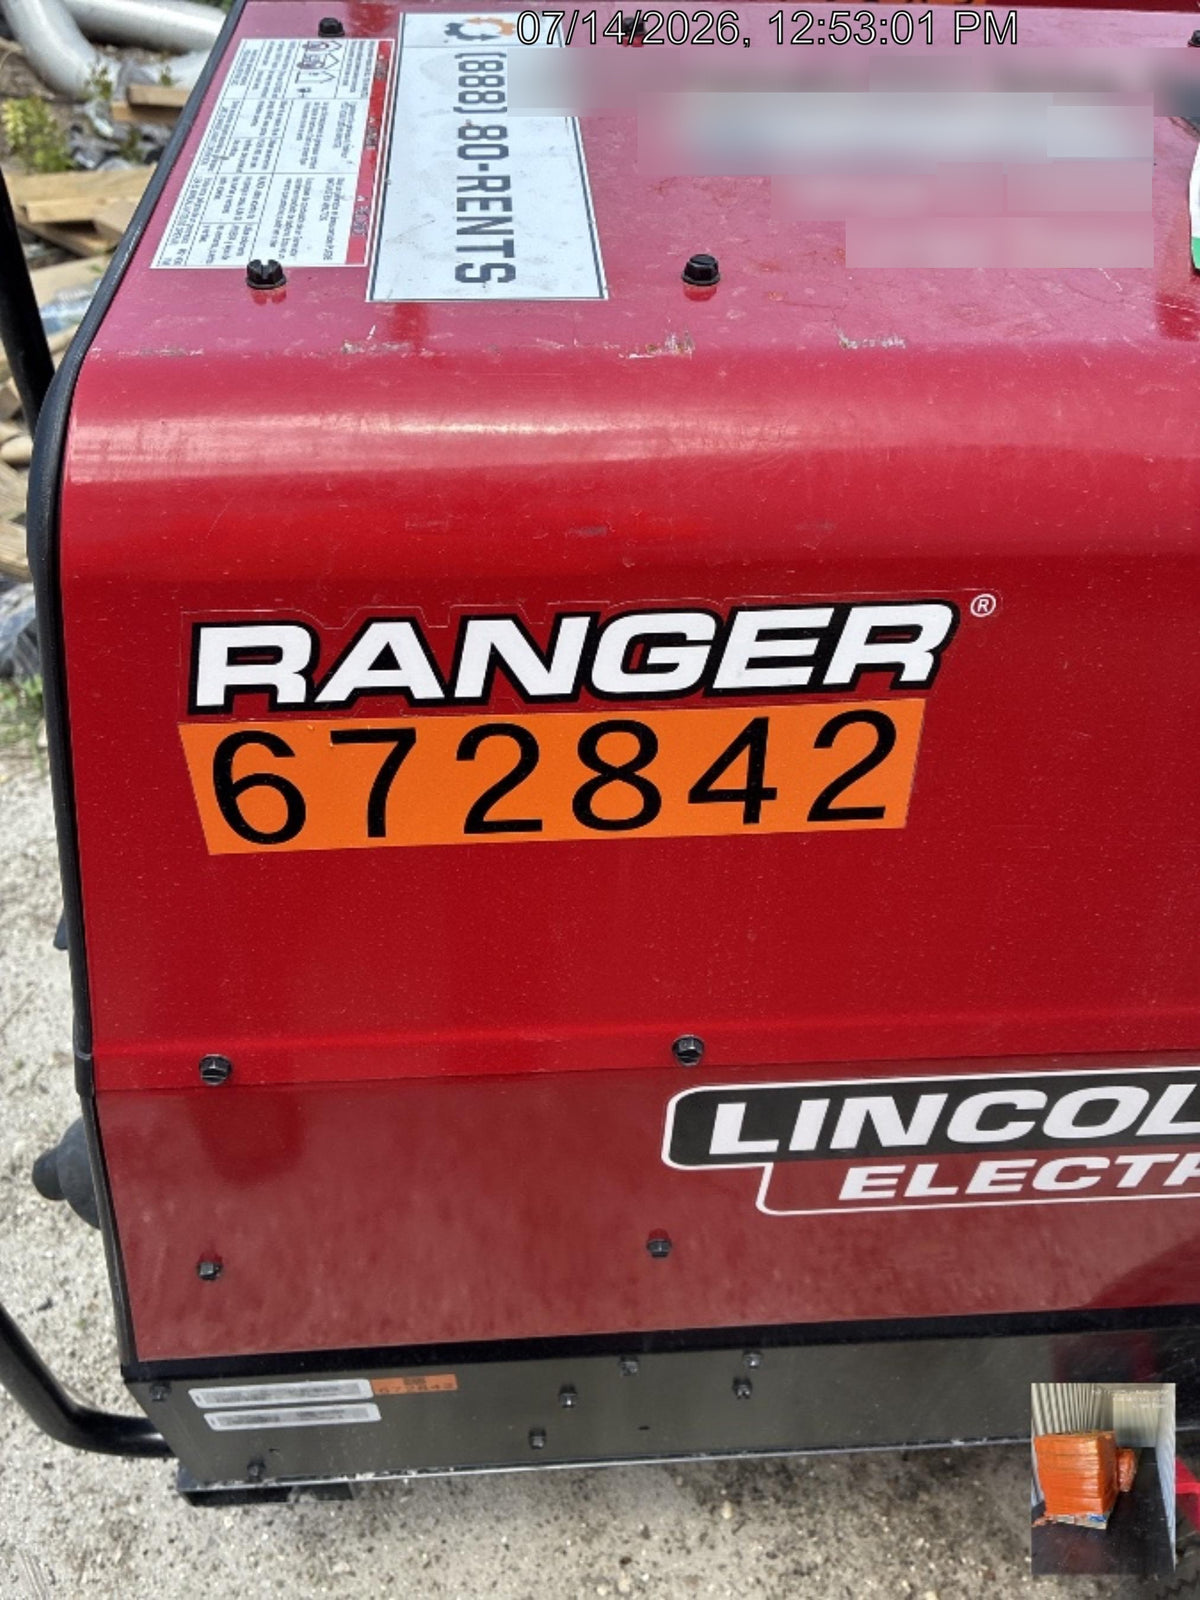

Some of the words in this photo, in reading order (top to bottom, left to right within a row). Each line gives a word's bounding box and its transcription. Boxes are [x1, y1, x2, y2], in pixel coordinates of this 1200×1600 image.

[453, 52, 508, 114] (888)
[455, 124, 516, 284] 80-RENTS
[190, 600, 959, 712] RANGER
[212, 709, 897, 845] 672842
[708, 1083, 1200, 1155] LINCOL
